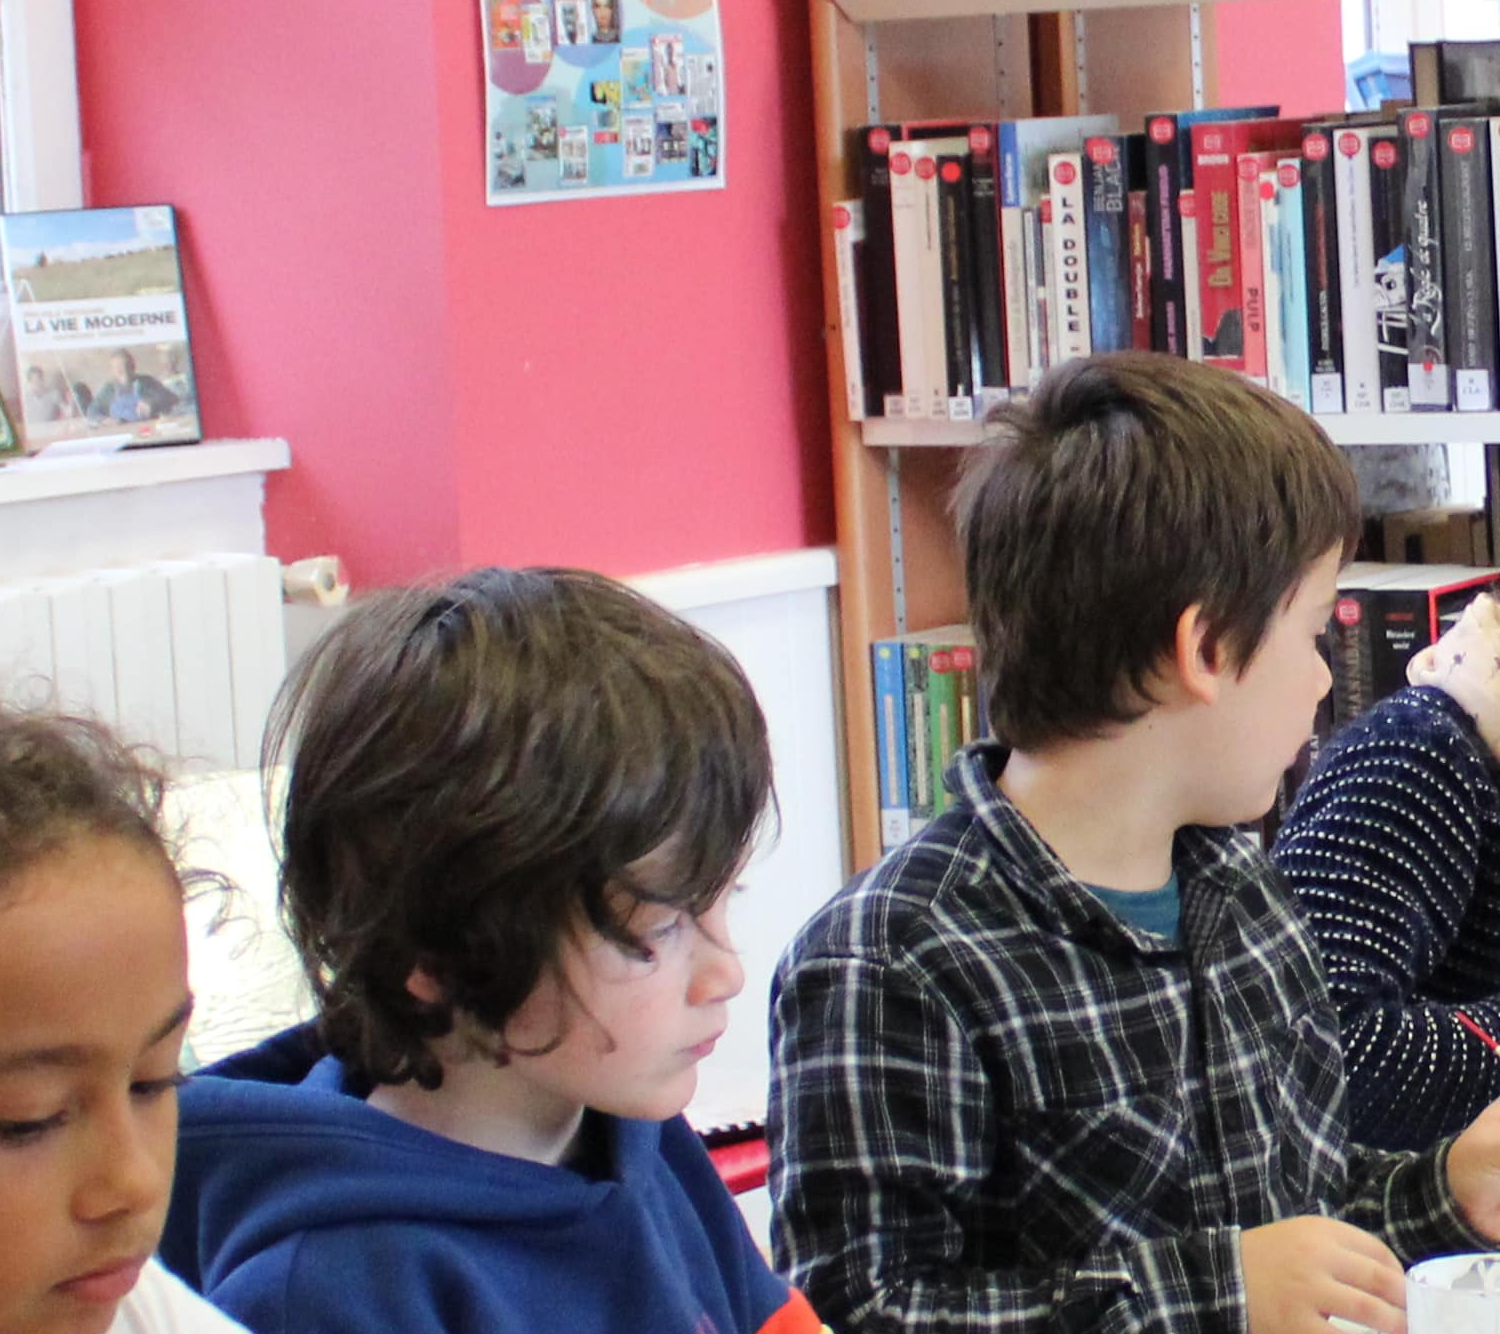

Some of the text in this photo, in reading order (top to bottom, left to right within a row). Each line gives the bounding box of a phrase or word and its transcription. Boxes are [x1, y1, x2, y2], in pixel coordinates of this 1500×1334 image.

[1061, 196, 1081, 333] LA DOUBLE
[24, 318, 46, 334] LA
[49, 316, 79, 332] VIE
[84, 310, 176, 330] MODERNE
[1247, 287, 1260, 332] PULP
